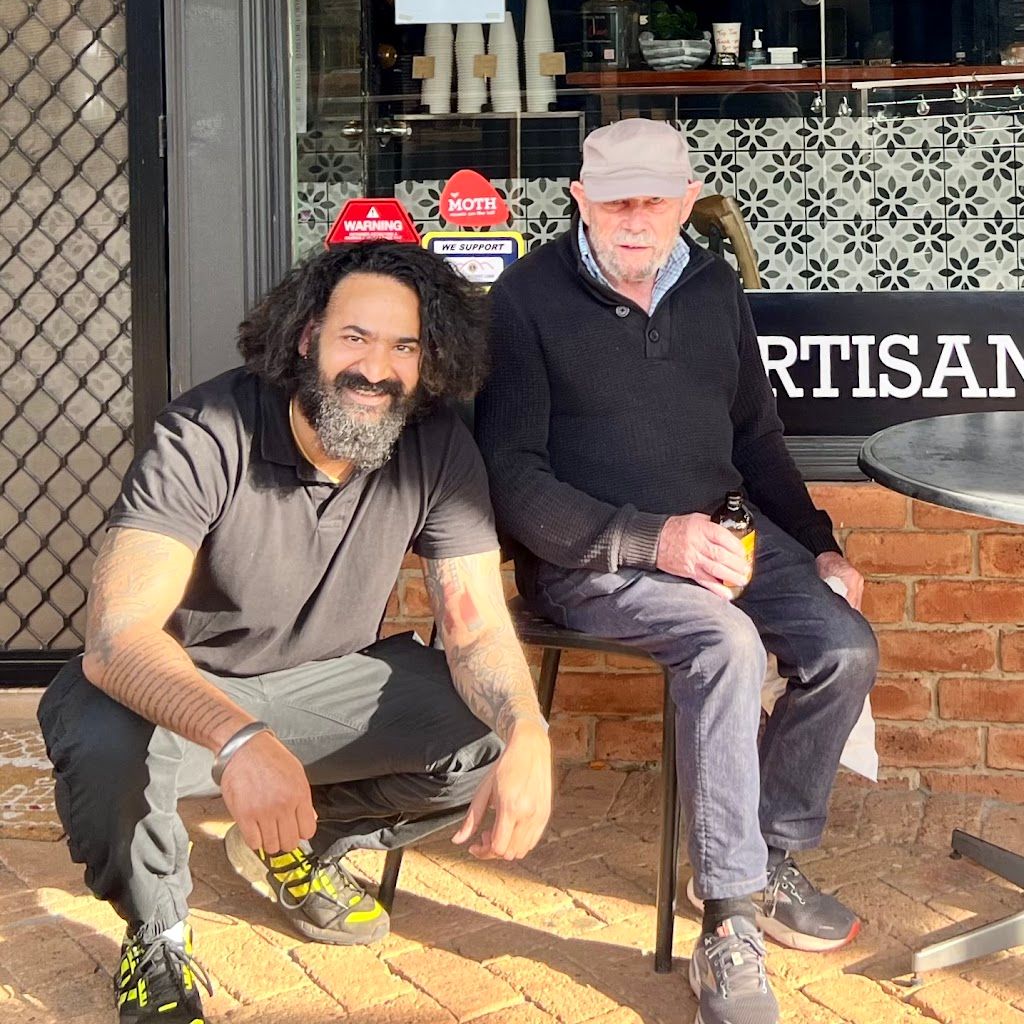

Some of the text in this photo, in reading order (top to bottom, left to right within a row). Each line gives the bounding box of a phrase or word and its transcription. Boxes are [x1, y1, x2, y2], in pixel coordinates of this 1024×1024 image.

[448, 197, 497, 212] MOTH
[343, 220, 403, 232] WARNING
[441, 243, 505, 251] WE SUPPORT
